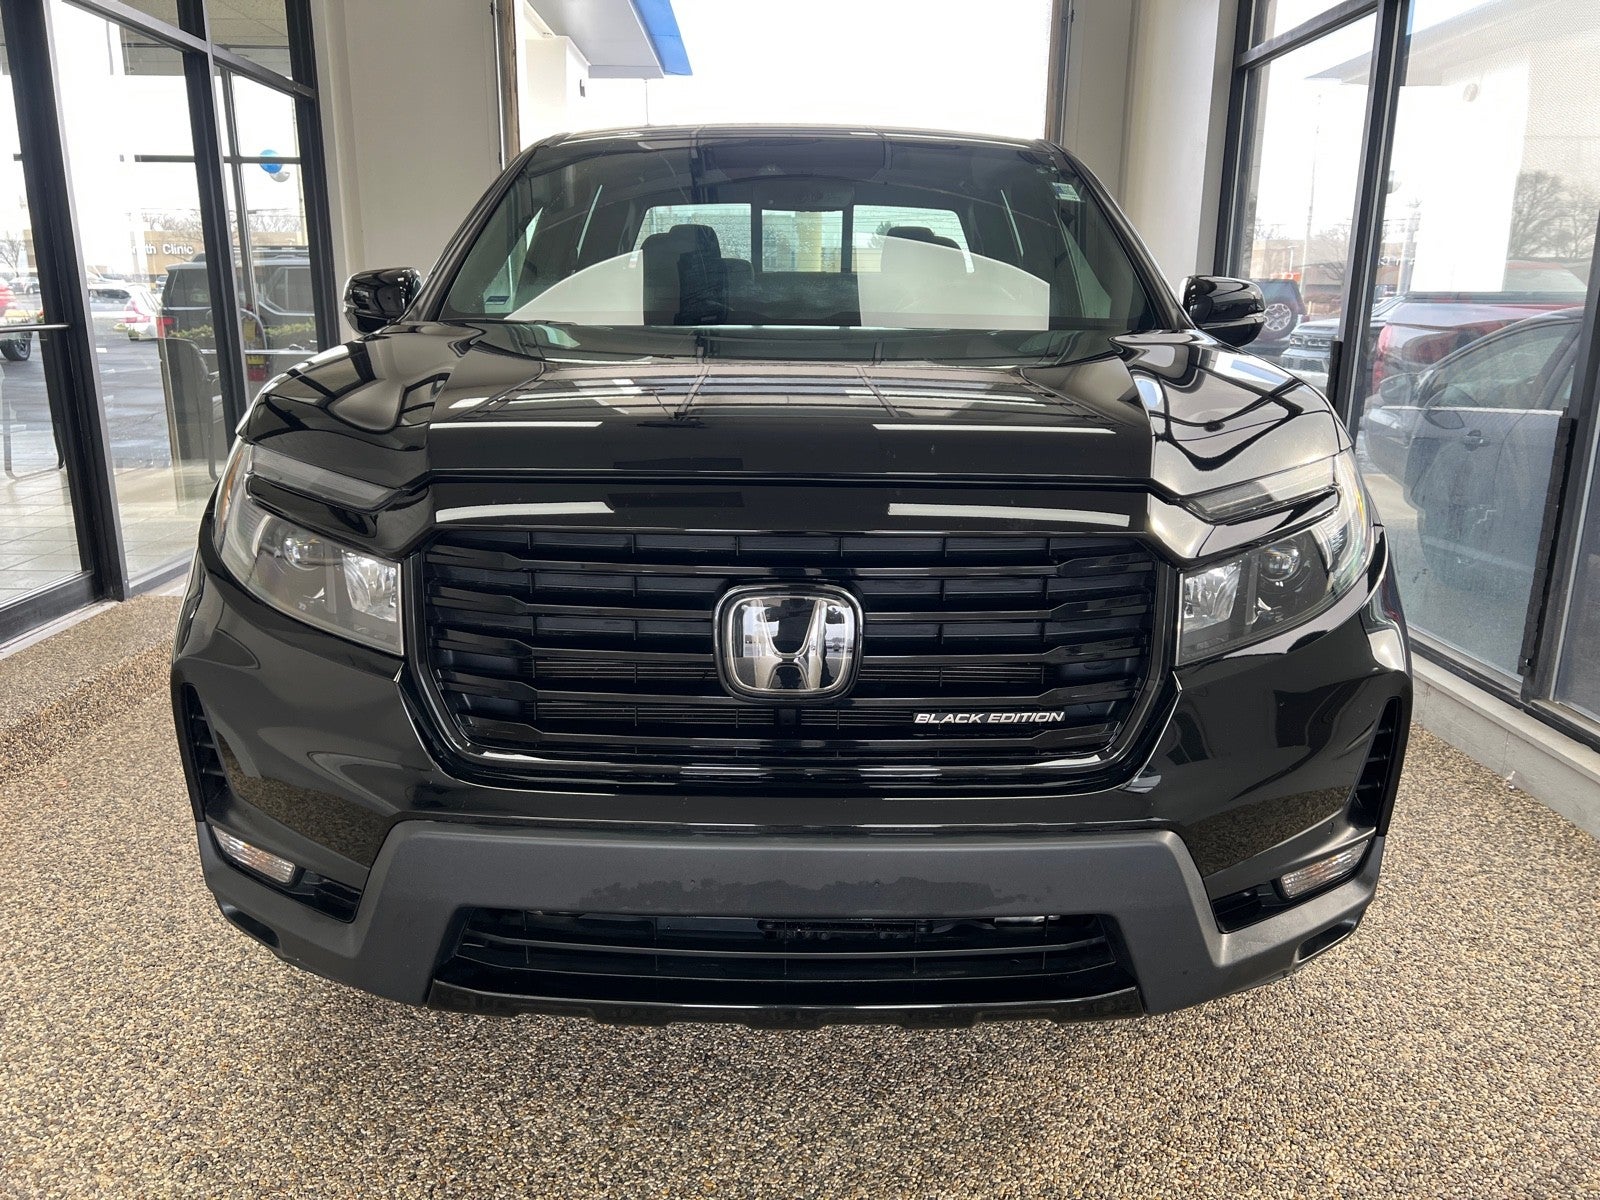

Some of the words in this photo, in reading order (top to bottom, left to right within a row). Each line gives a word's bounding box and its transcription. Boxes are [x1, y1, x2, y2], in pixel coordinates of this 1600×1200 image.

[162, 243, 194, 255] Clinic
[914, 713, 985, 724] BLACK
[987, 711, 1065, 723] EDITION
